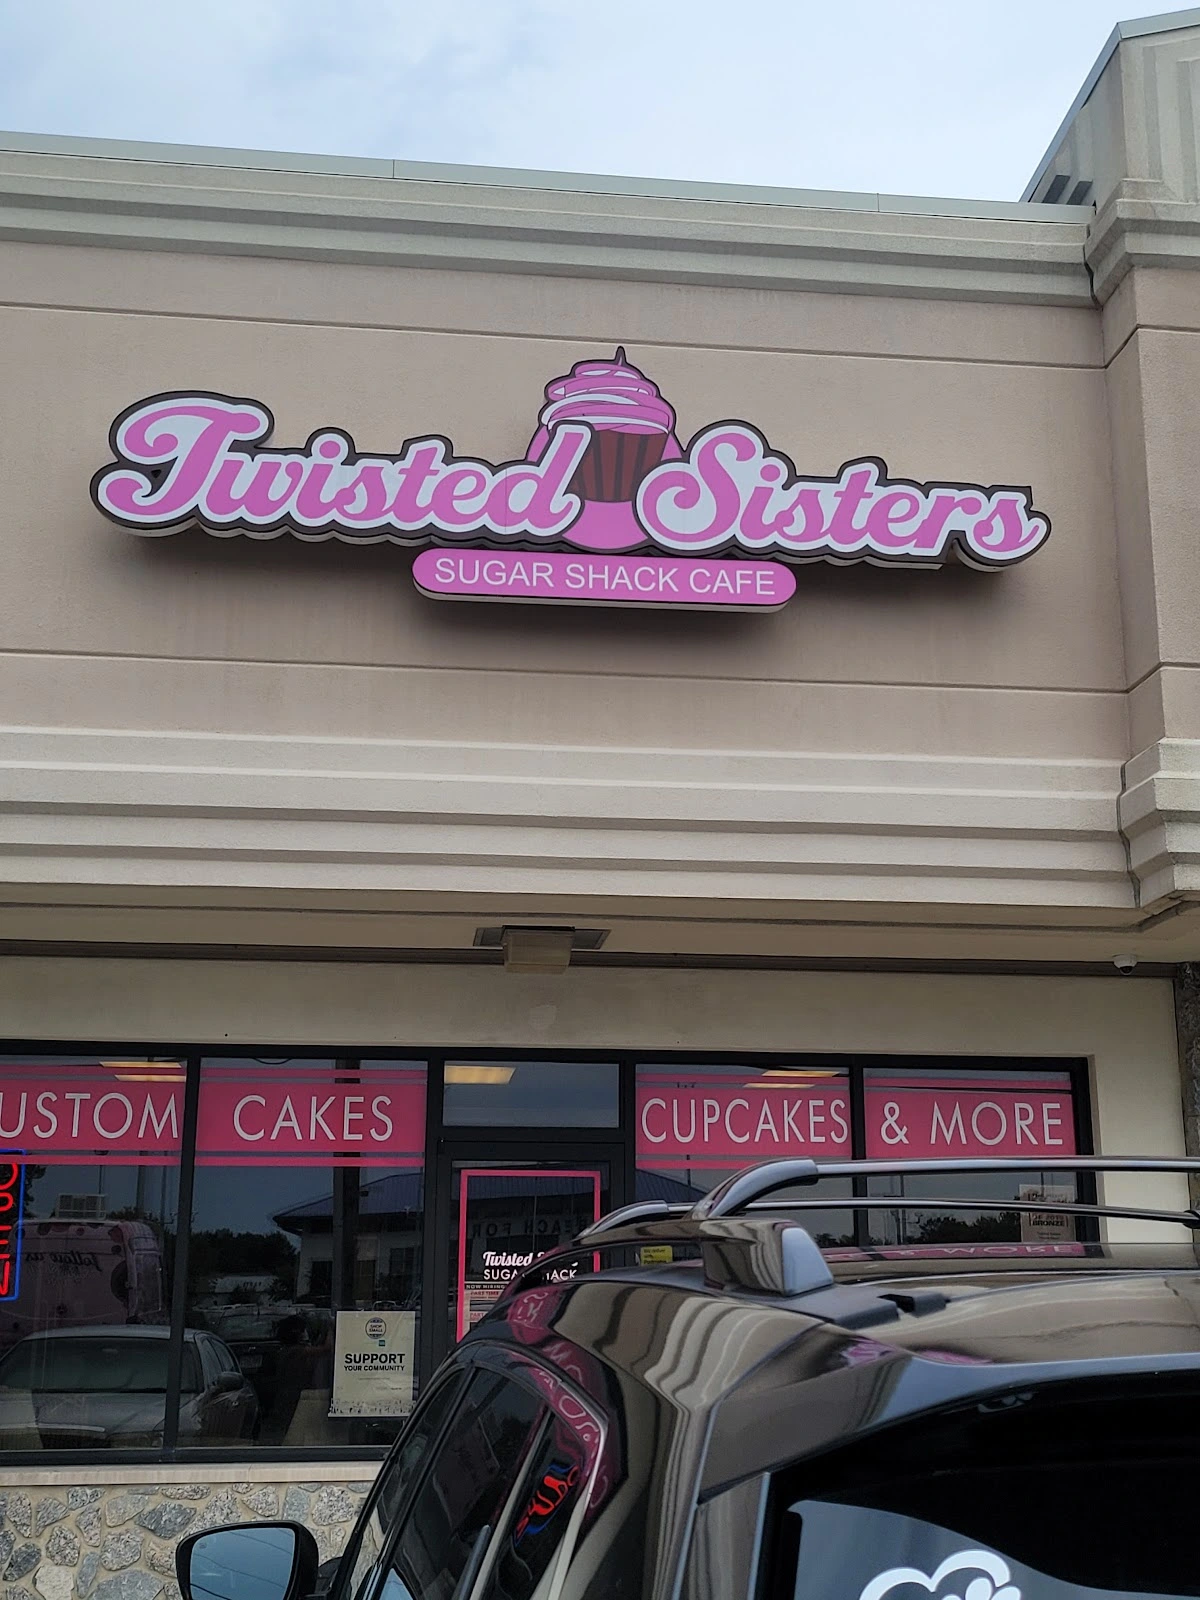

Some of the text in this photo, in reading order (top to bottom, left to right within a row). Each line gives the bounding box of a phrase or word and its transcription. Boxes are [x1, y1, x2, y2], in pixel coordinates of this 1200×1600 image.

[102, 401, 1042, 557] Twisted Sisters
[434, 557, 776, 596] SUGAR SHACK CAFE
[233, 1094, 394, 1142] CAKES
[641, 1097, 848, 1144] CUPCAKES
[880, 1101, 909, 1145] &
[930, 1101, 1064, 1146] MORE
[482, 1251, 534, 1267] Twisted
[483, 1268, 578, 1281] SUGA ACK
[344, 1353, 405, 1364] SUPPORT
